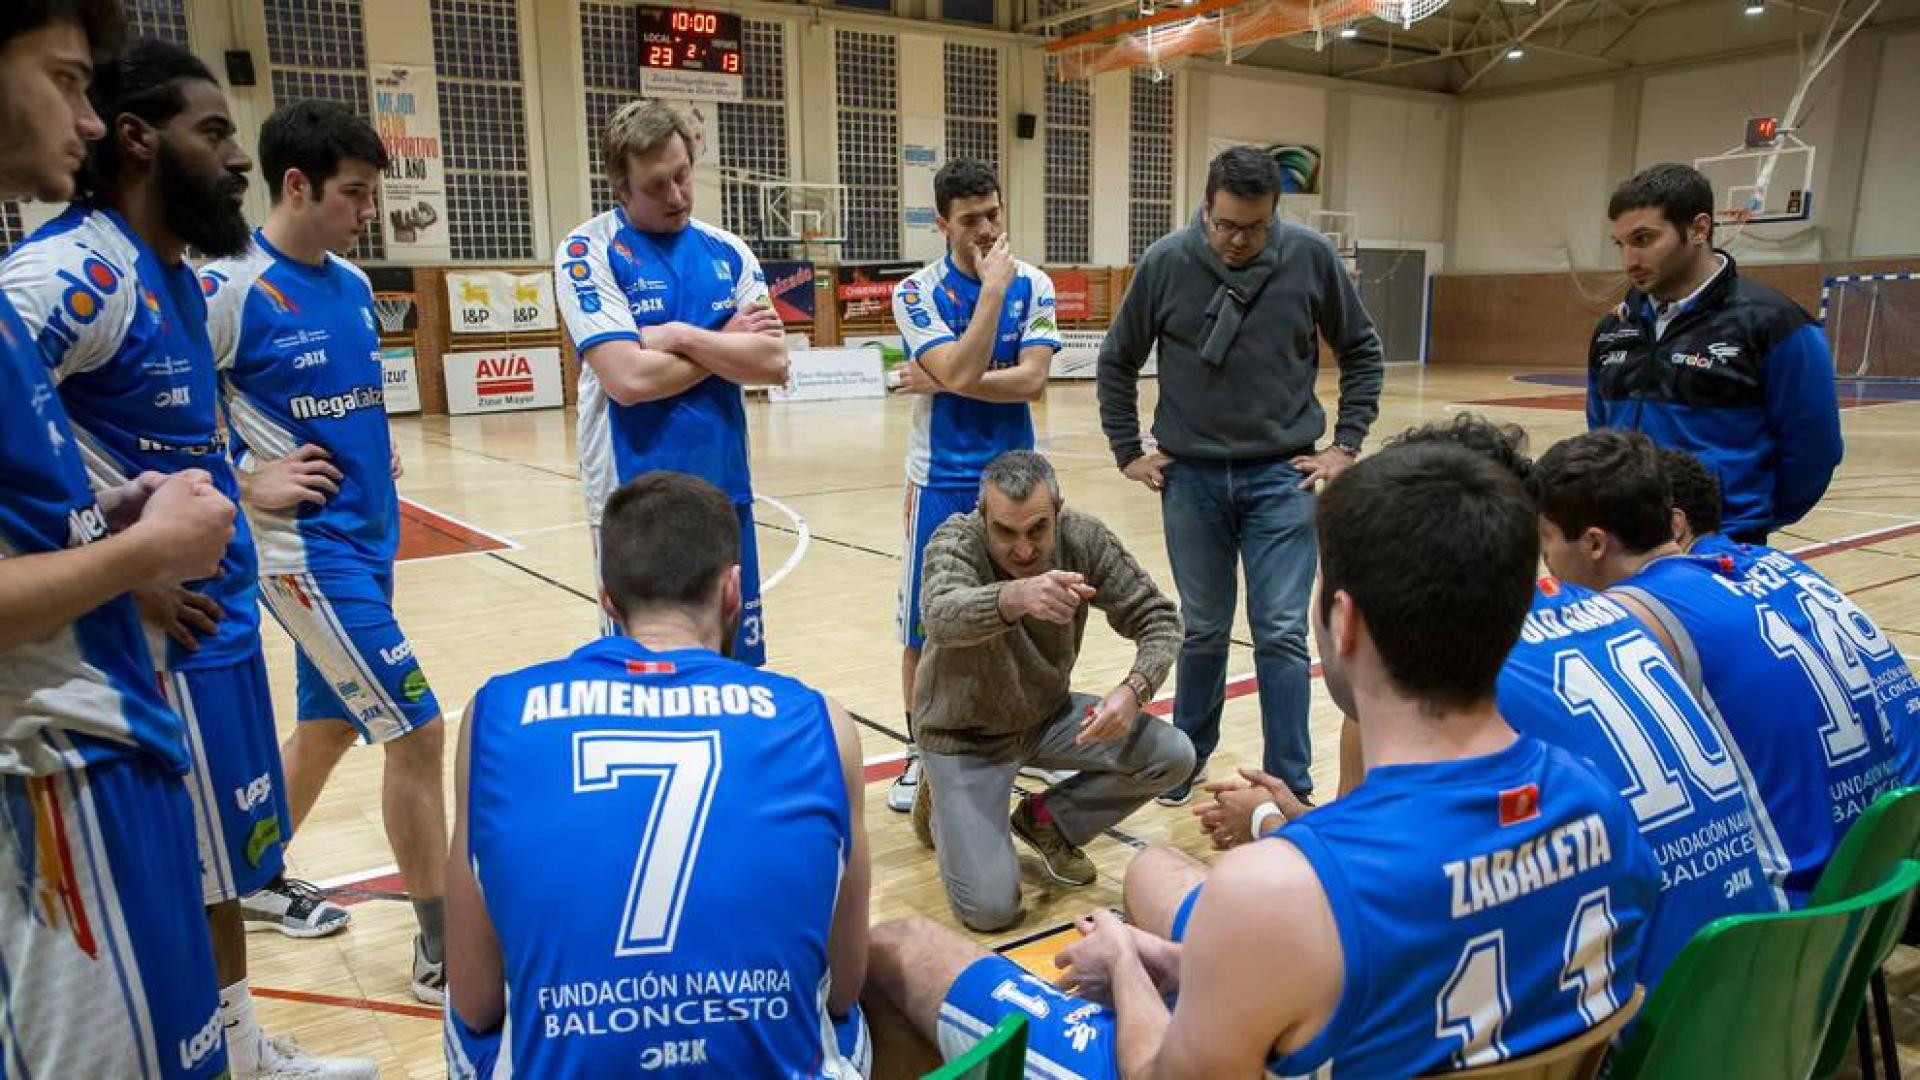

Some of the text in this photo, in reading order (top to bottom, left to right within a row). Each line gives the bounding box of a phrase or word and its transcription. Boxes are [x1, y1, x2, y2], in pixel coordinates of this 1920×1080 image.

[672, 12, 717, 33] 10:00
[649, 46, 672, 66] 23
[686, 43, 697, 59] 2
[722, 53, 739, 72] 13
[377, 91, 415, 115] MEJOR
[462, 307, 490, 324] I&P
[513, 306, 539, 323] I&P
[521, 680, 777, 725] ALMENDROS
[1553, 628, 1744, 833] 10
[572, 729, 723, 957] 7
[1442, 812, 1613, 920] ZABALETA
[538, 969, 791, 1010] FUNDACIÓN NAVARRA
[1436, 886, 1621, 1070] 11
[544, 996, 790, 1039] BALONCESTO
[663, 1038, 707, 1066] BZK
